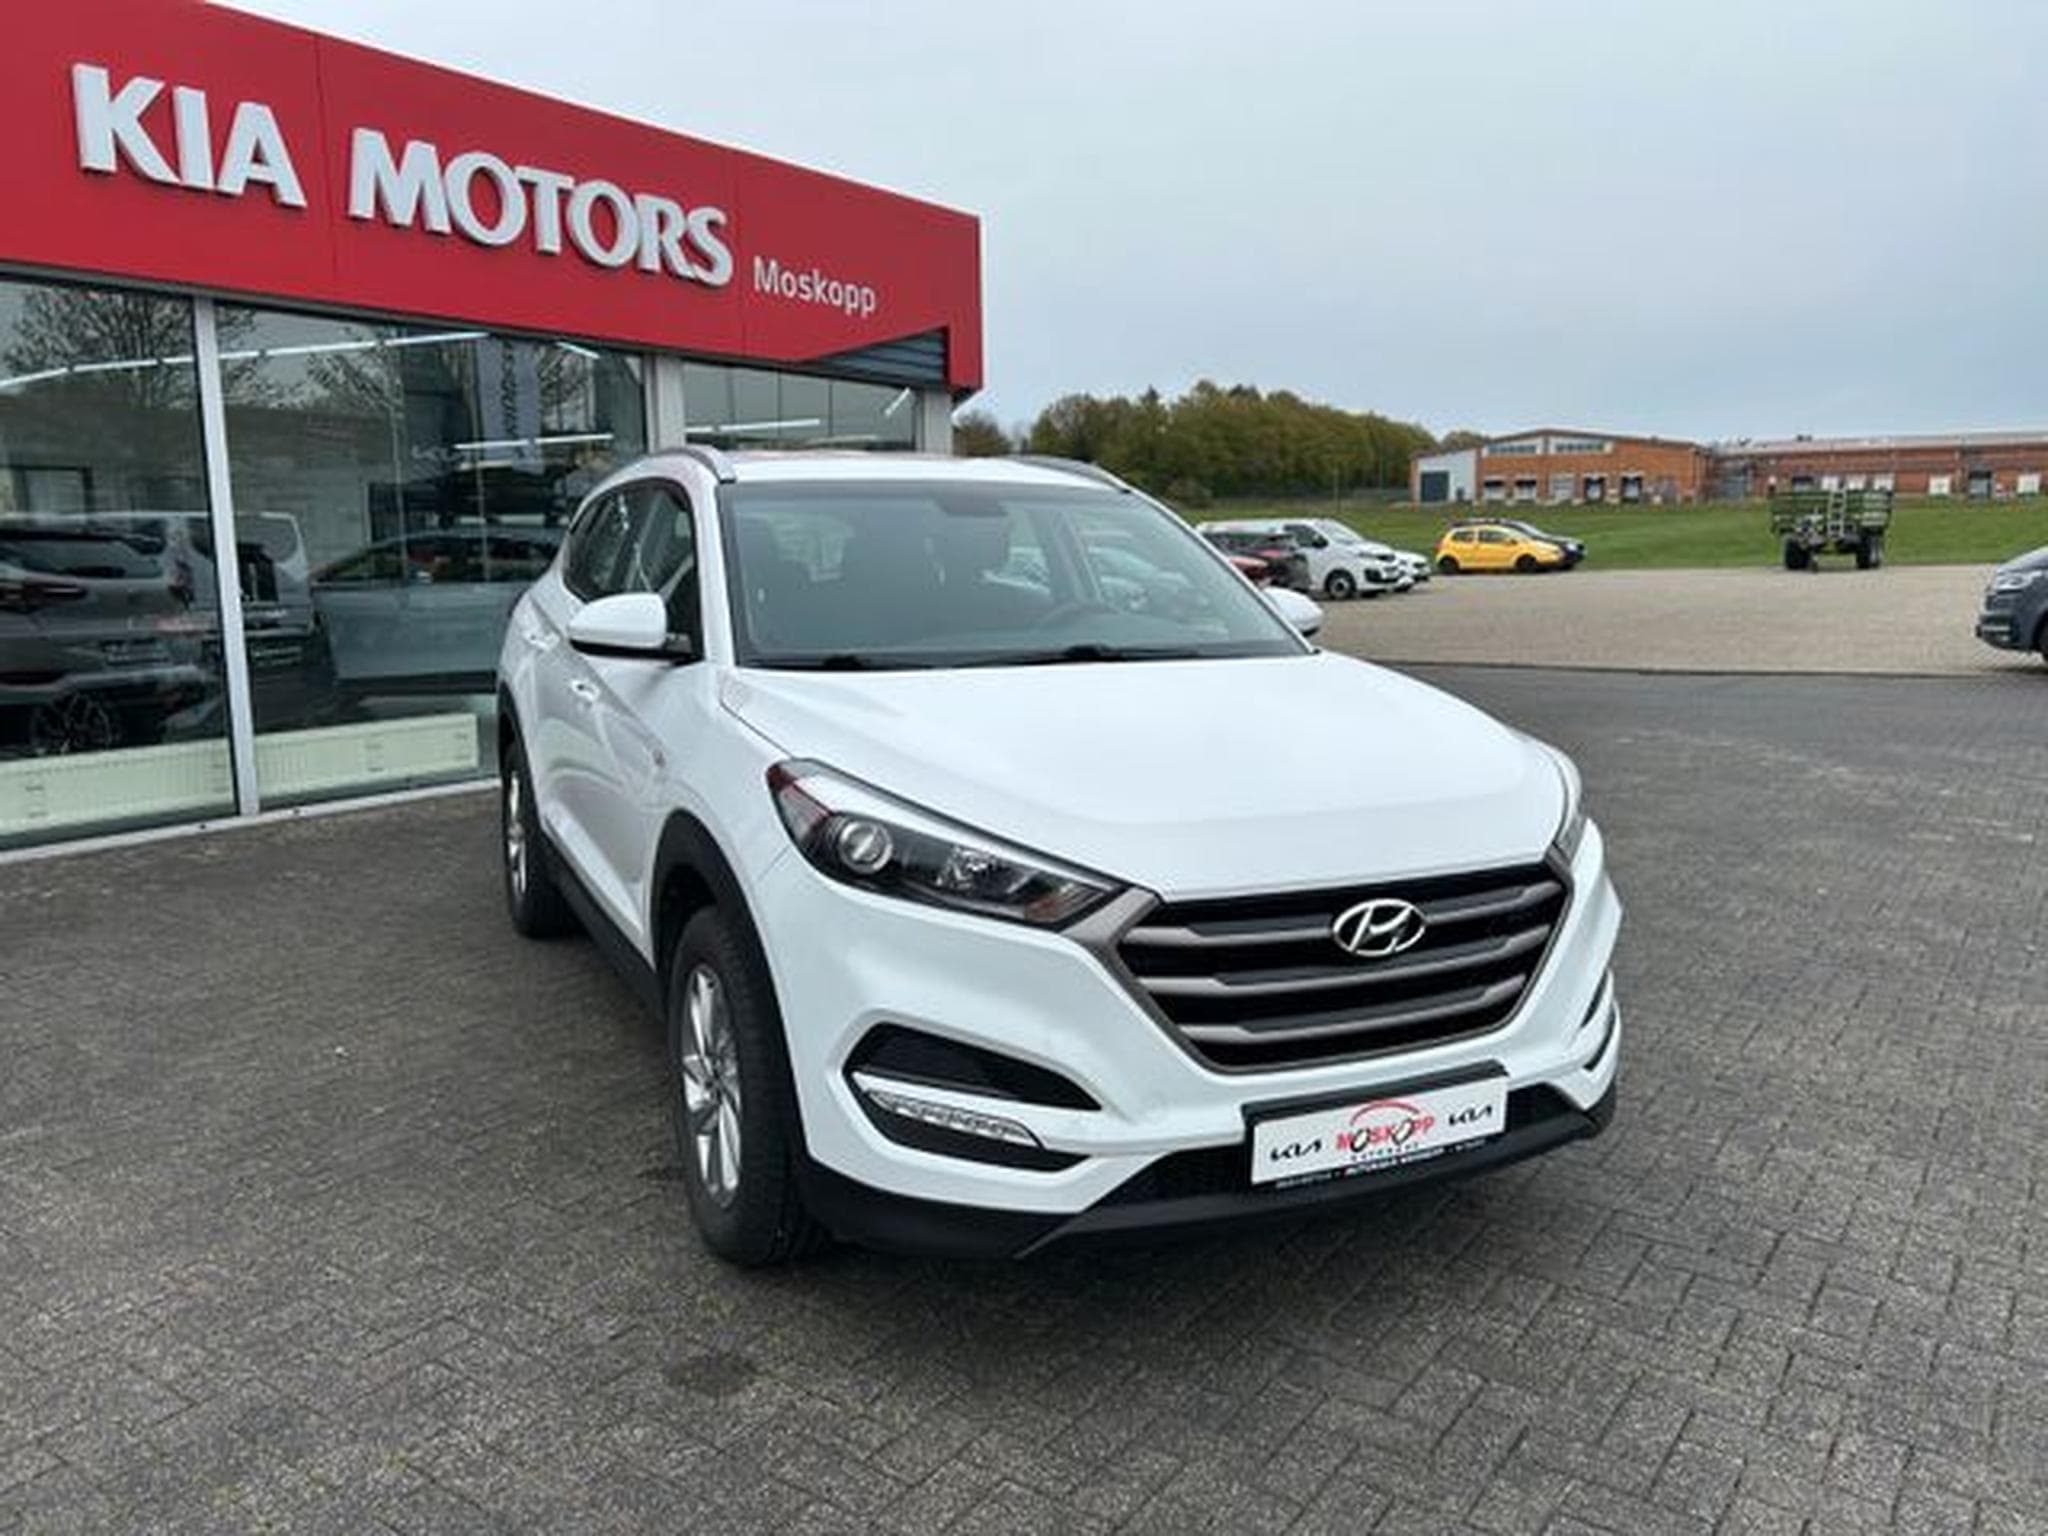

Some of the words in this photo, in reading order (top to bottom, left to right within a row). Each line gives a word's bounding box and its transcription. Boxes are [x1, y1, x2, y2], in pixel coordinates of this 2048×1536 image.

[73, 63, 306, 208] KIA
[348, 127, 734, 288] MOTORS
[753, 254, 877, 319] Moskopp
[1336, 1117, 1435, 1153] MOSKOPP
